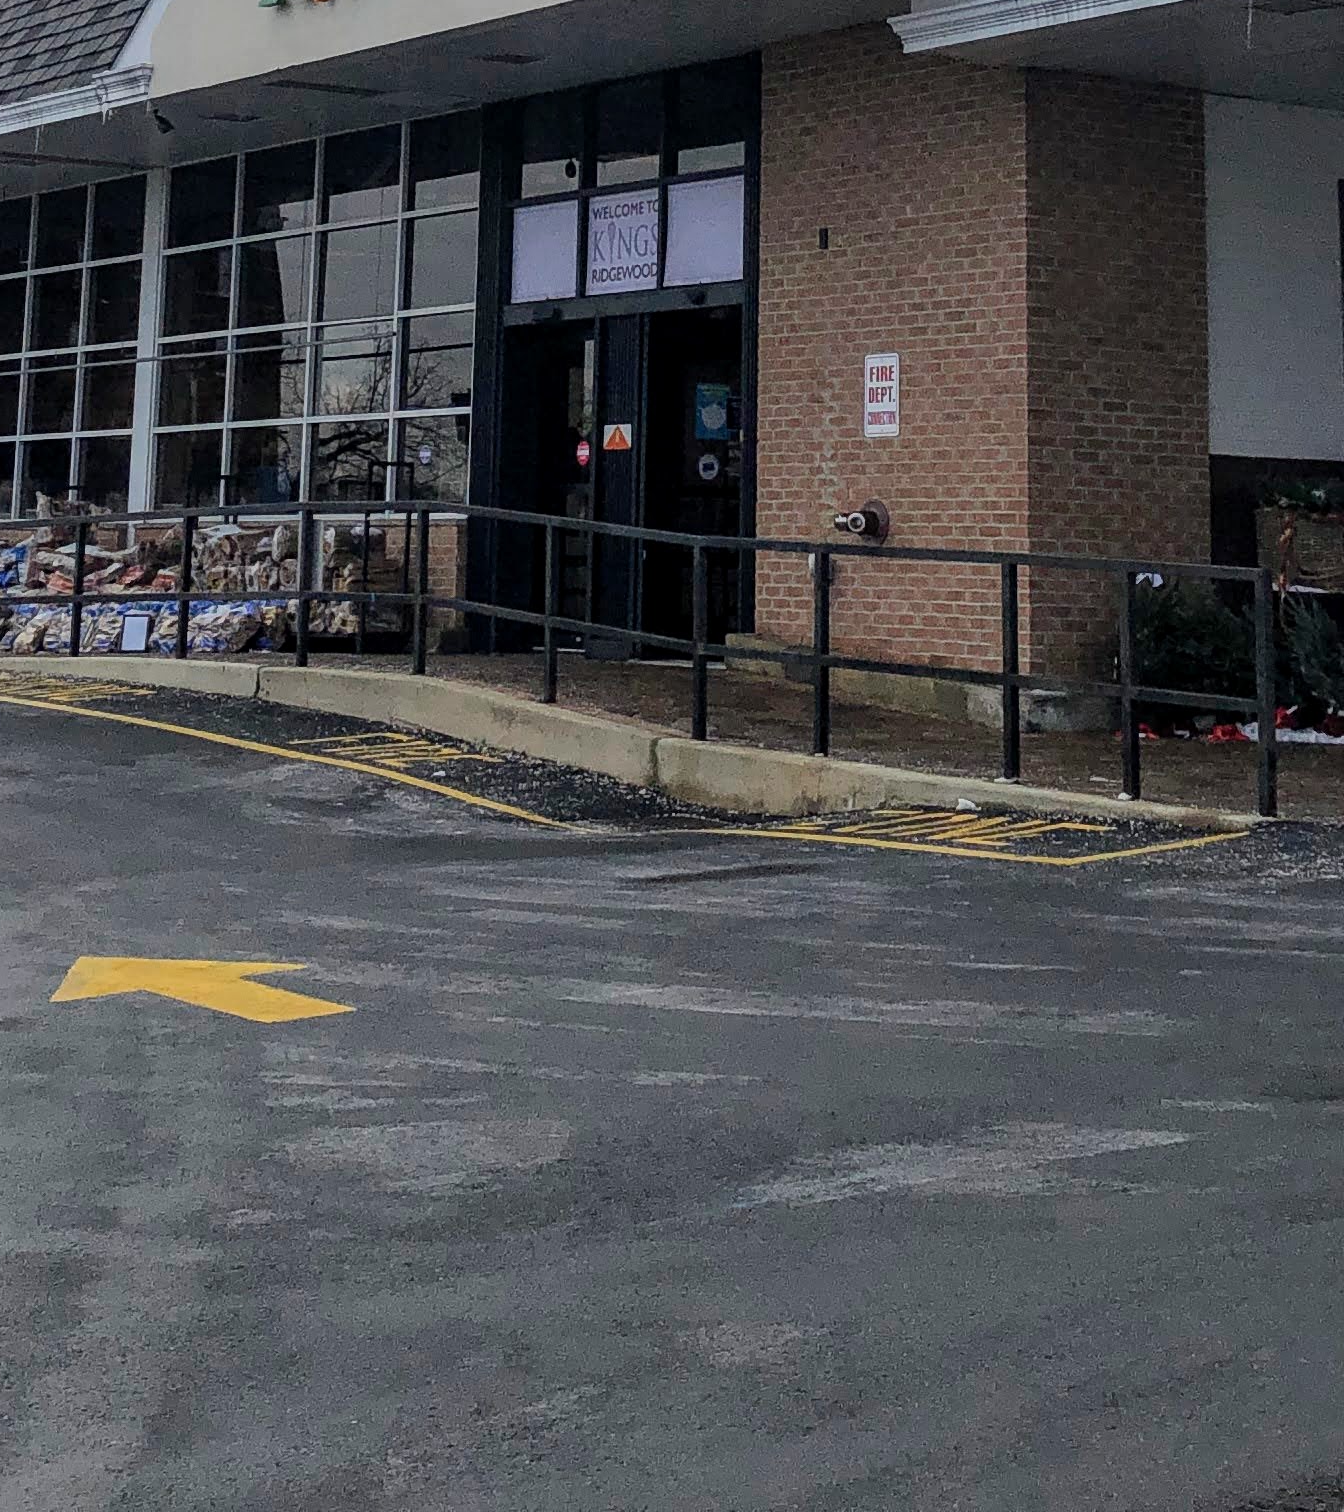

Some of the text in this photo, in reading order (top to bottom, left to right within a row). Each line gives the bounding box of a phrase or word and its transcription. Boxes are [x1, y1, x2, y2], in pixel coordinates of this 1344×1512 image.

[592, 199, 658, 220] WELCOME TO
[592, 262, 657, 284] RIDGEWOOD
[869, 365, 895, 382] FIRE
[868, 385, 896, 403] DEPT.
